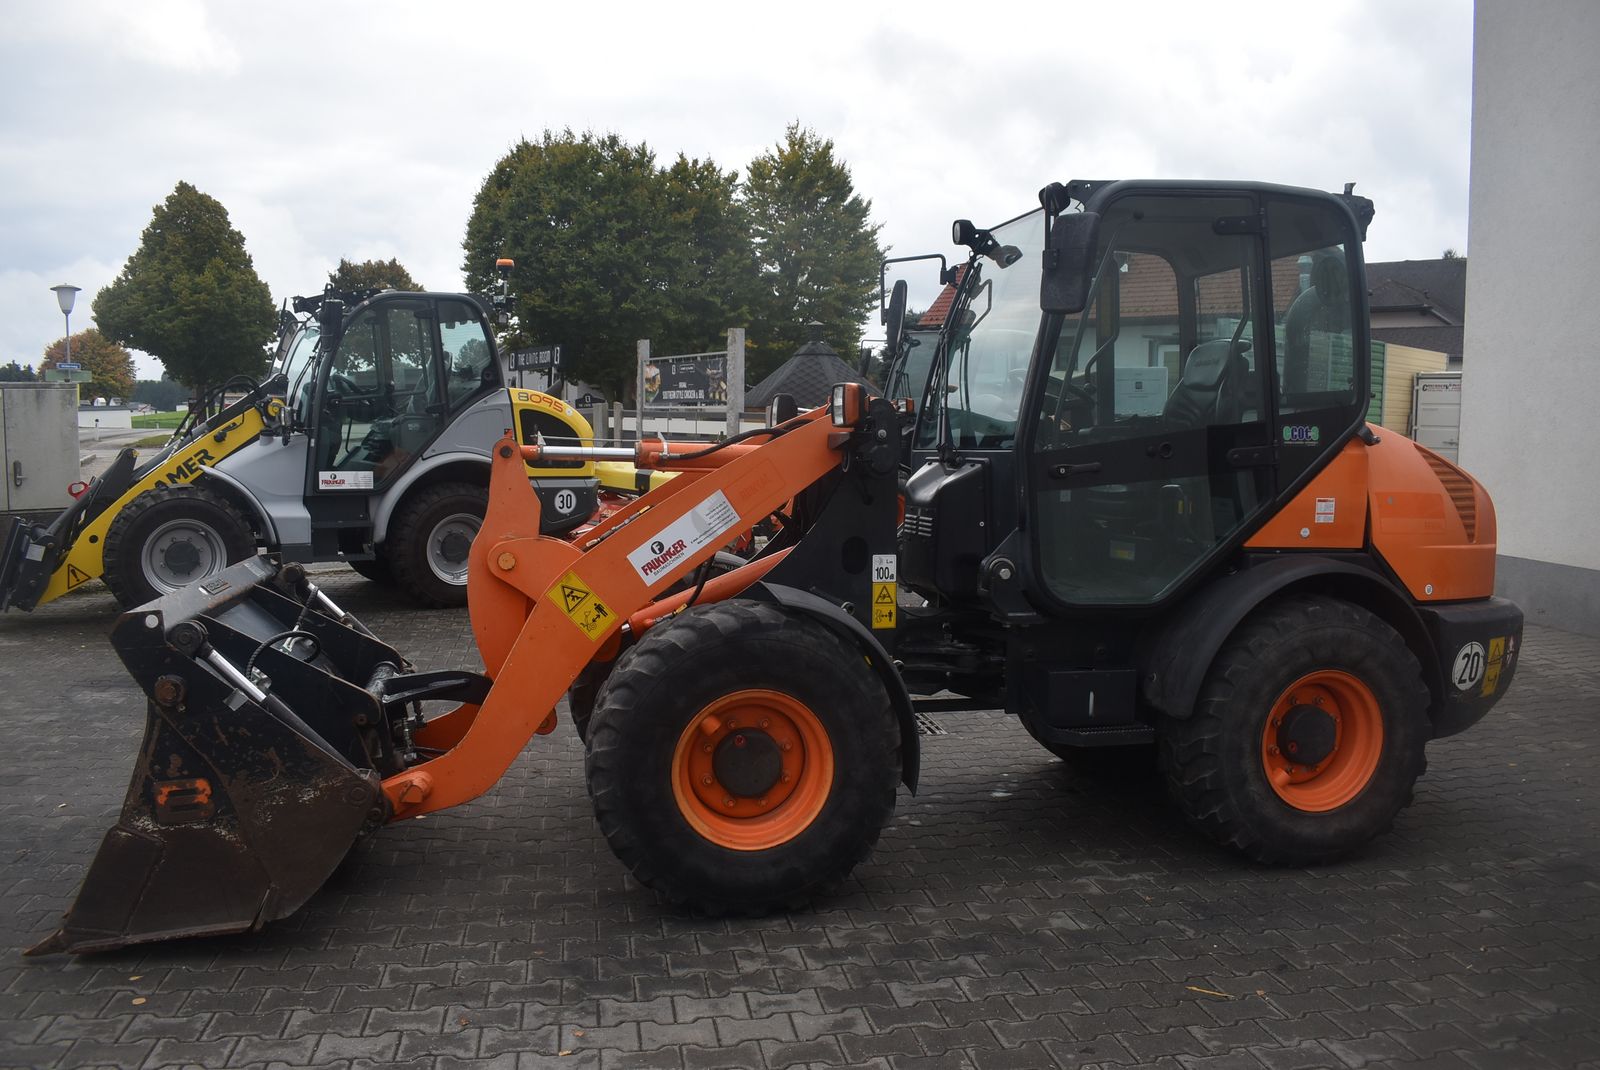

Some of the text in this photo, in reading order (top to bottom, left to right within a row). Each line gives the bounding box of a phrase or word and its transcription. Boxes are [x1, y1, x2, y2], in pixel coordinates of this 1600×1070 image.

[539, 350, 551, 363] ROOM
[518, 392, 564, 413] 8095
[154, 449, 215, 491] AMER
[558, 494, 572, 510] 30
[641, 539, 687, 576] FALKINGER
[875, 566, 889, 580] 100
[1457, 651, 1480, 685] 20
